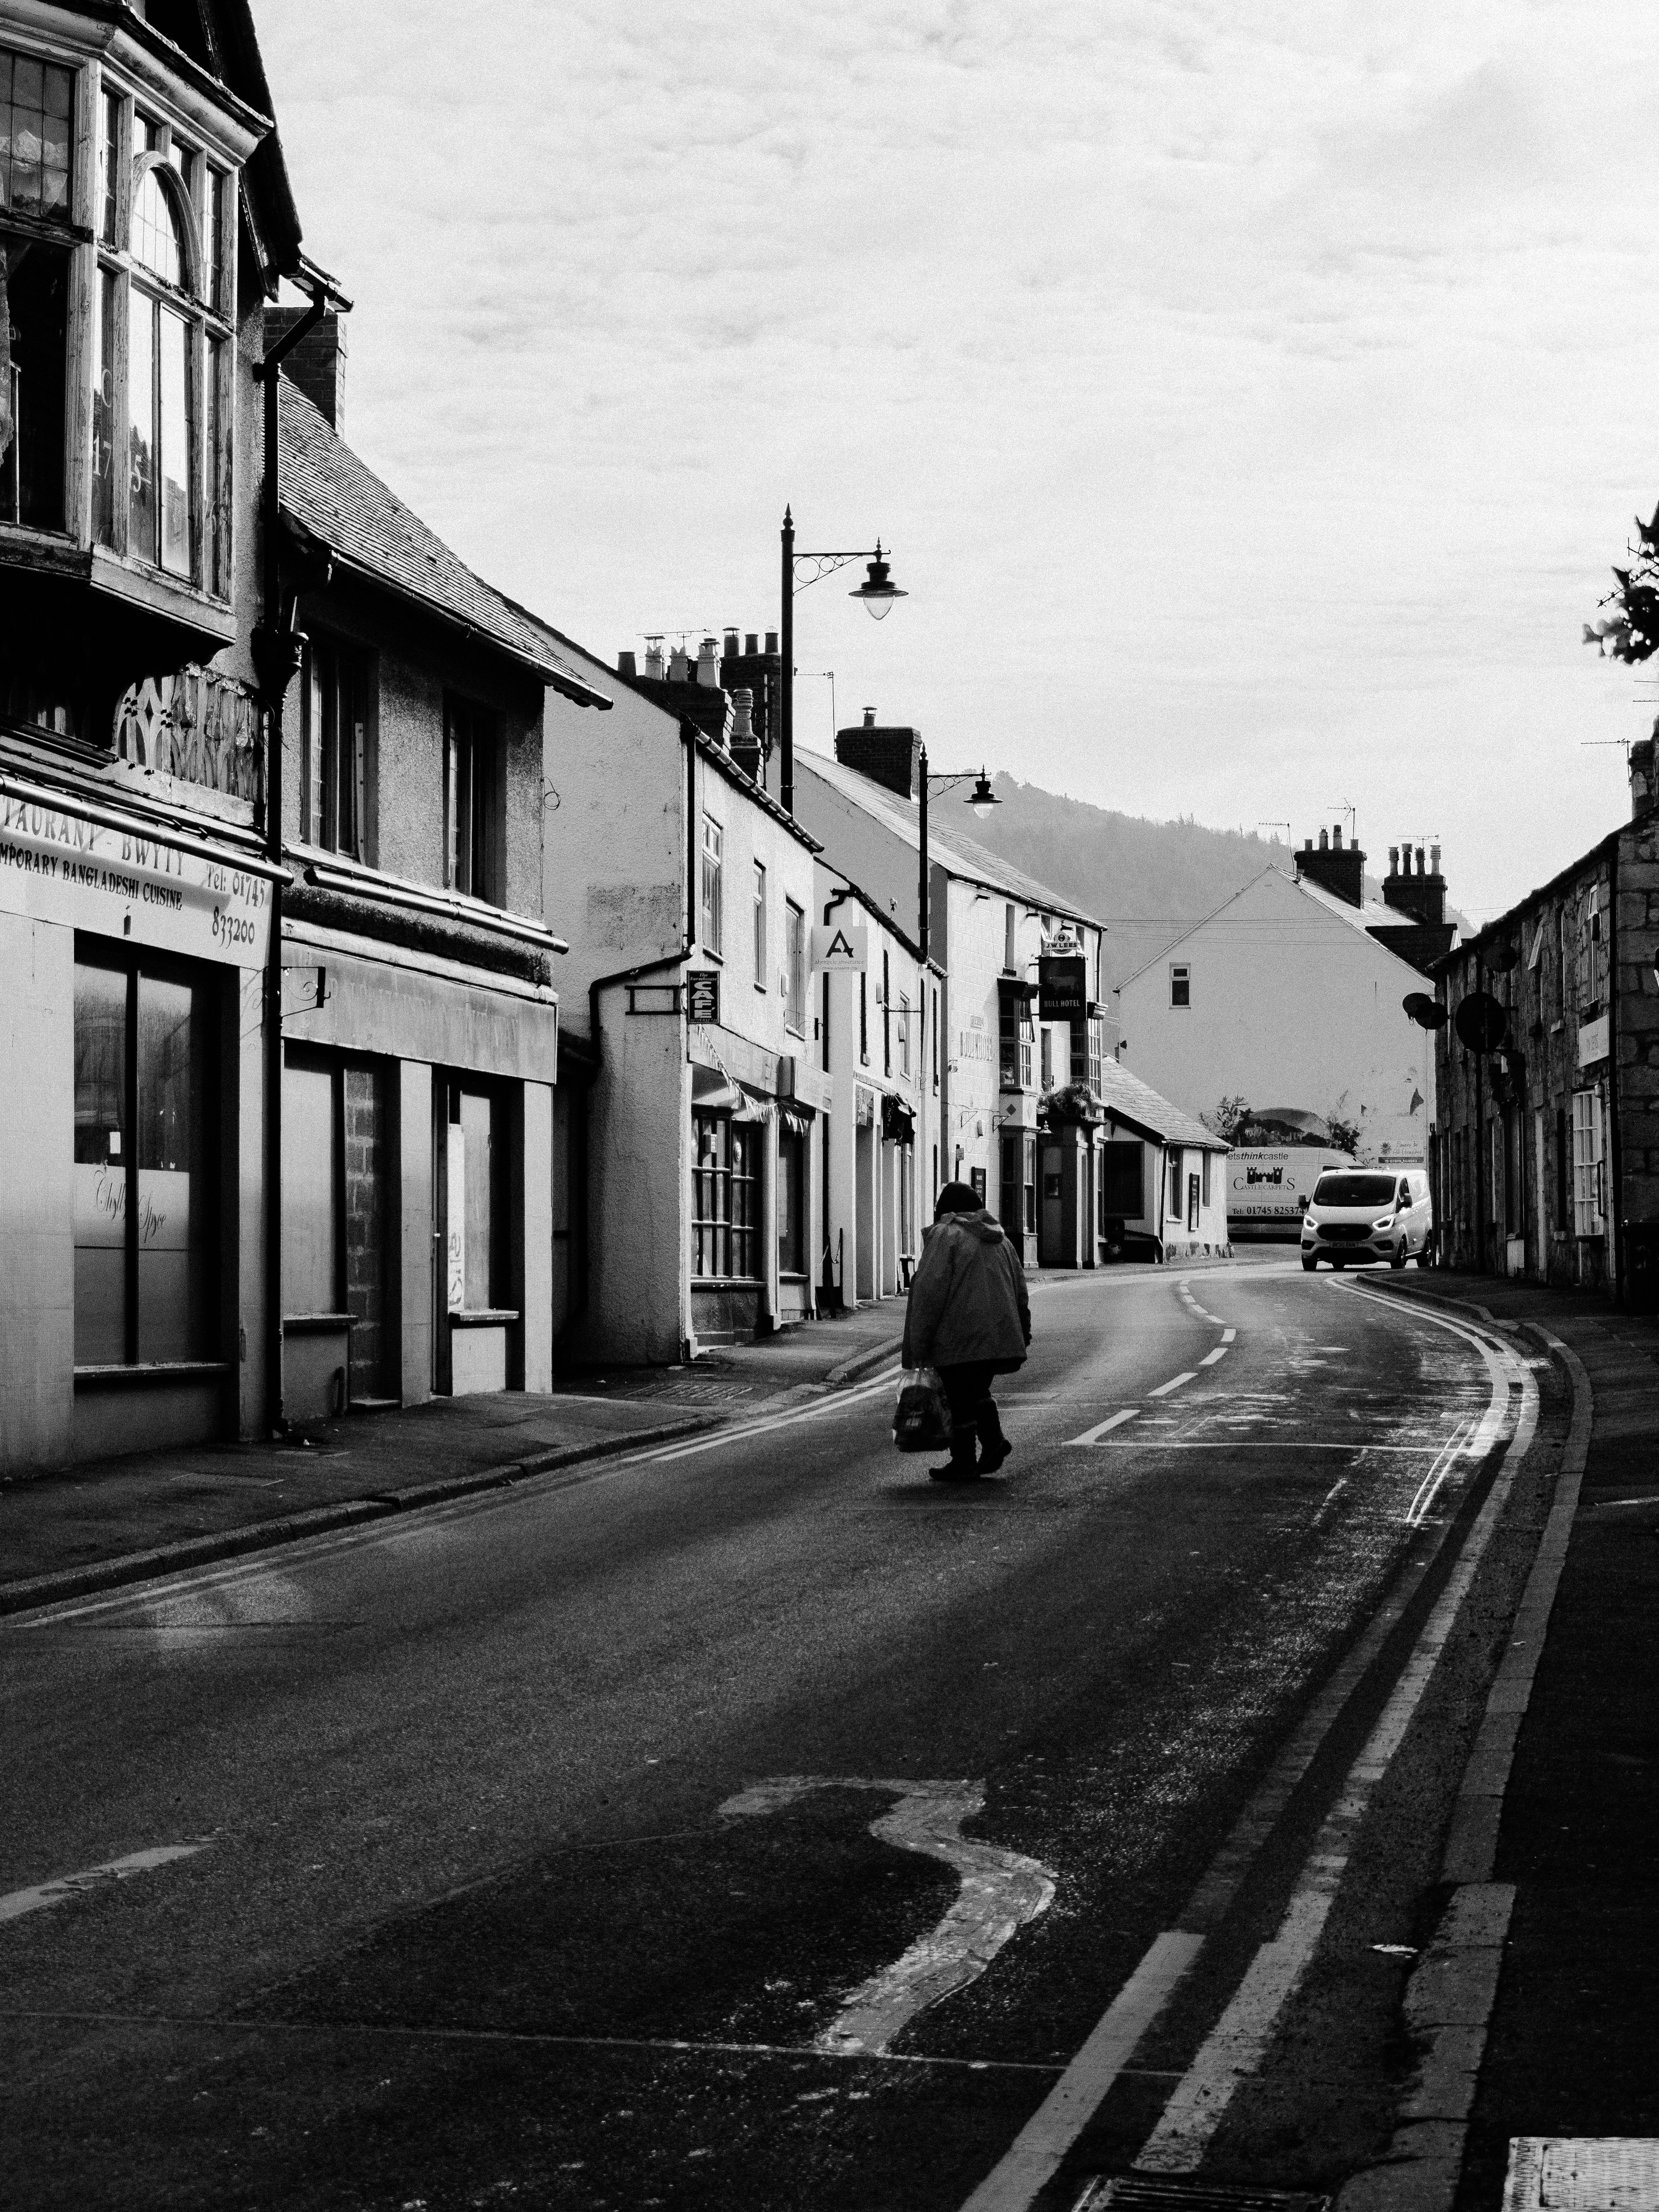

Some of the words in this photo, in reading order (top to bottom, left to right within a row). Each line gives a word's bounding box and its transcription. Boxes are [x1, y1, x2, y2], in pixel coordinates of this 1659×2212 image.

[62, 860, 140, 899] BANGLADESHI
[143, 882, 183, 911] CUISINE
[207, 863, 226, 891] Tel:
[233, 871, 265, 909] 01745
[212, 905, 255, 949] 833200
[1247, 1206, 1272, 1215] 01745
